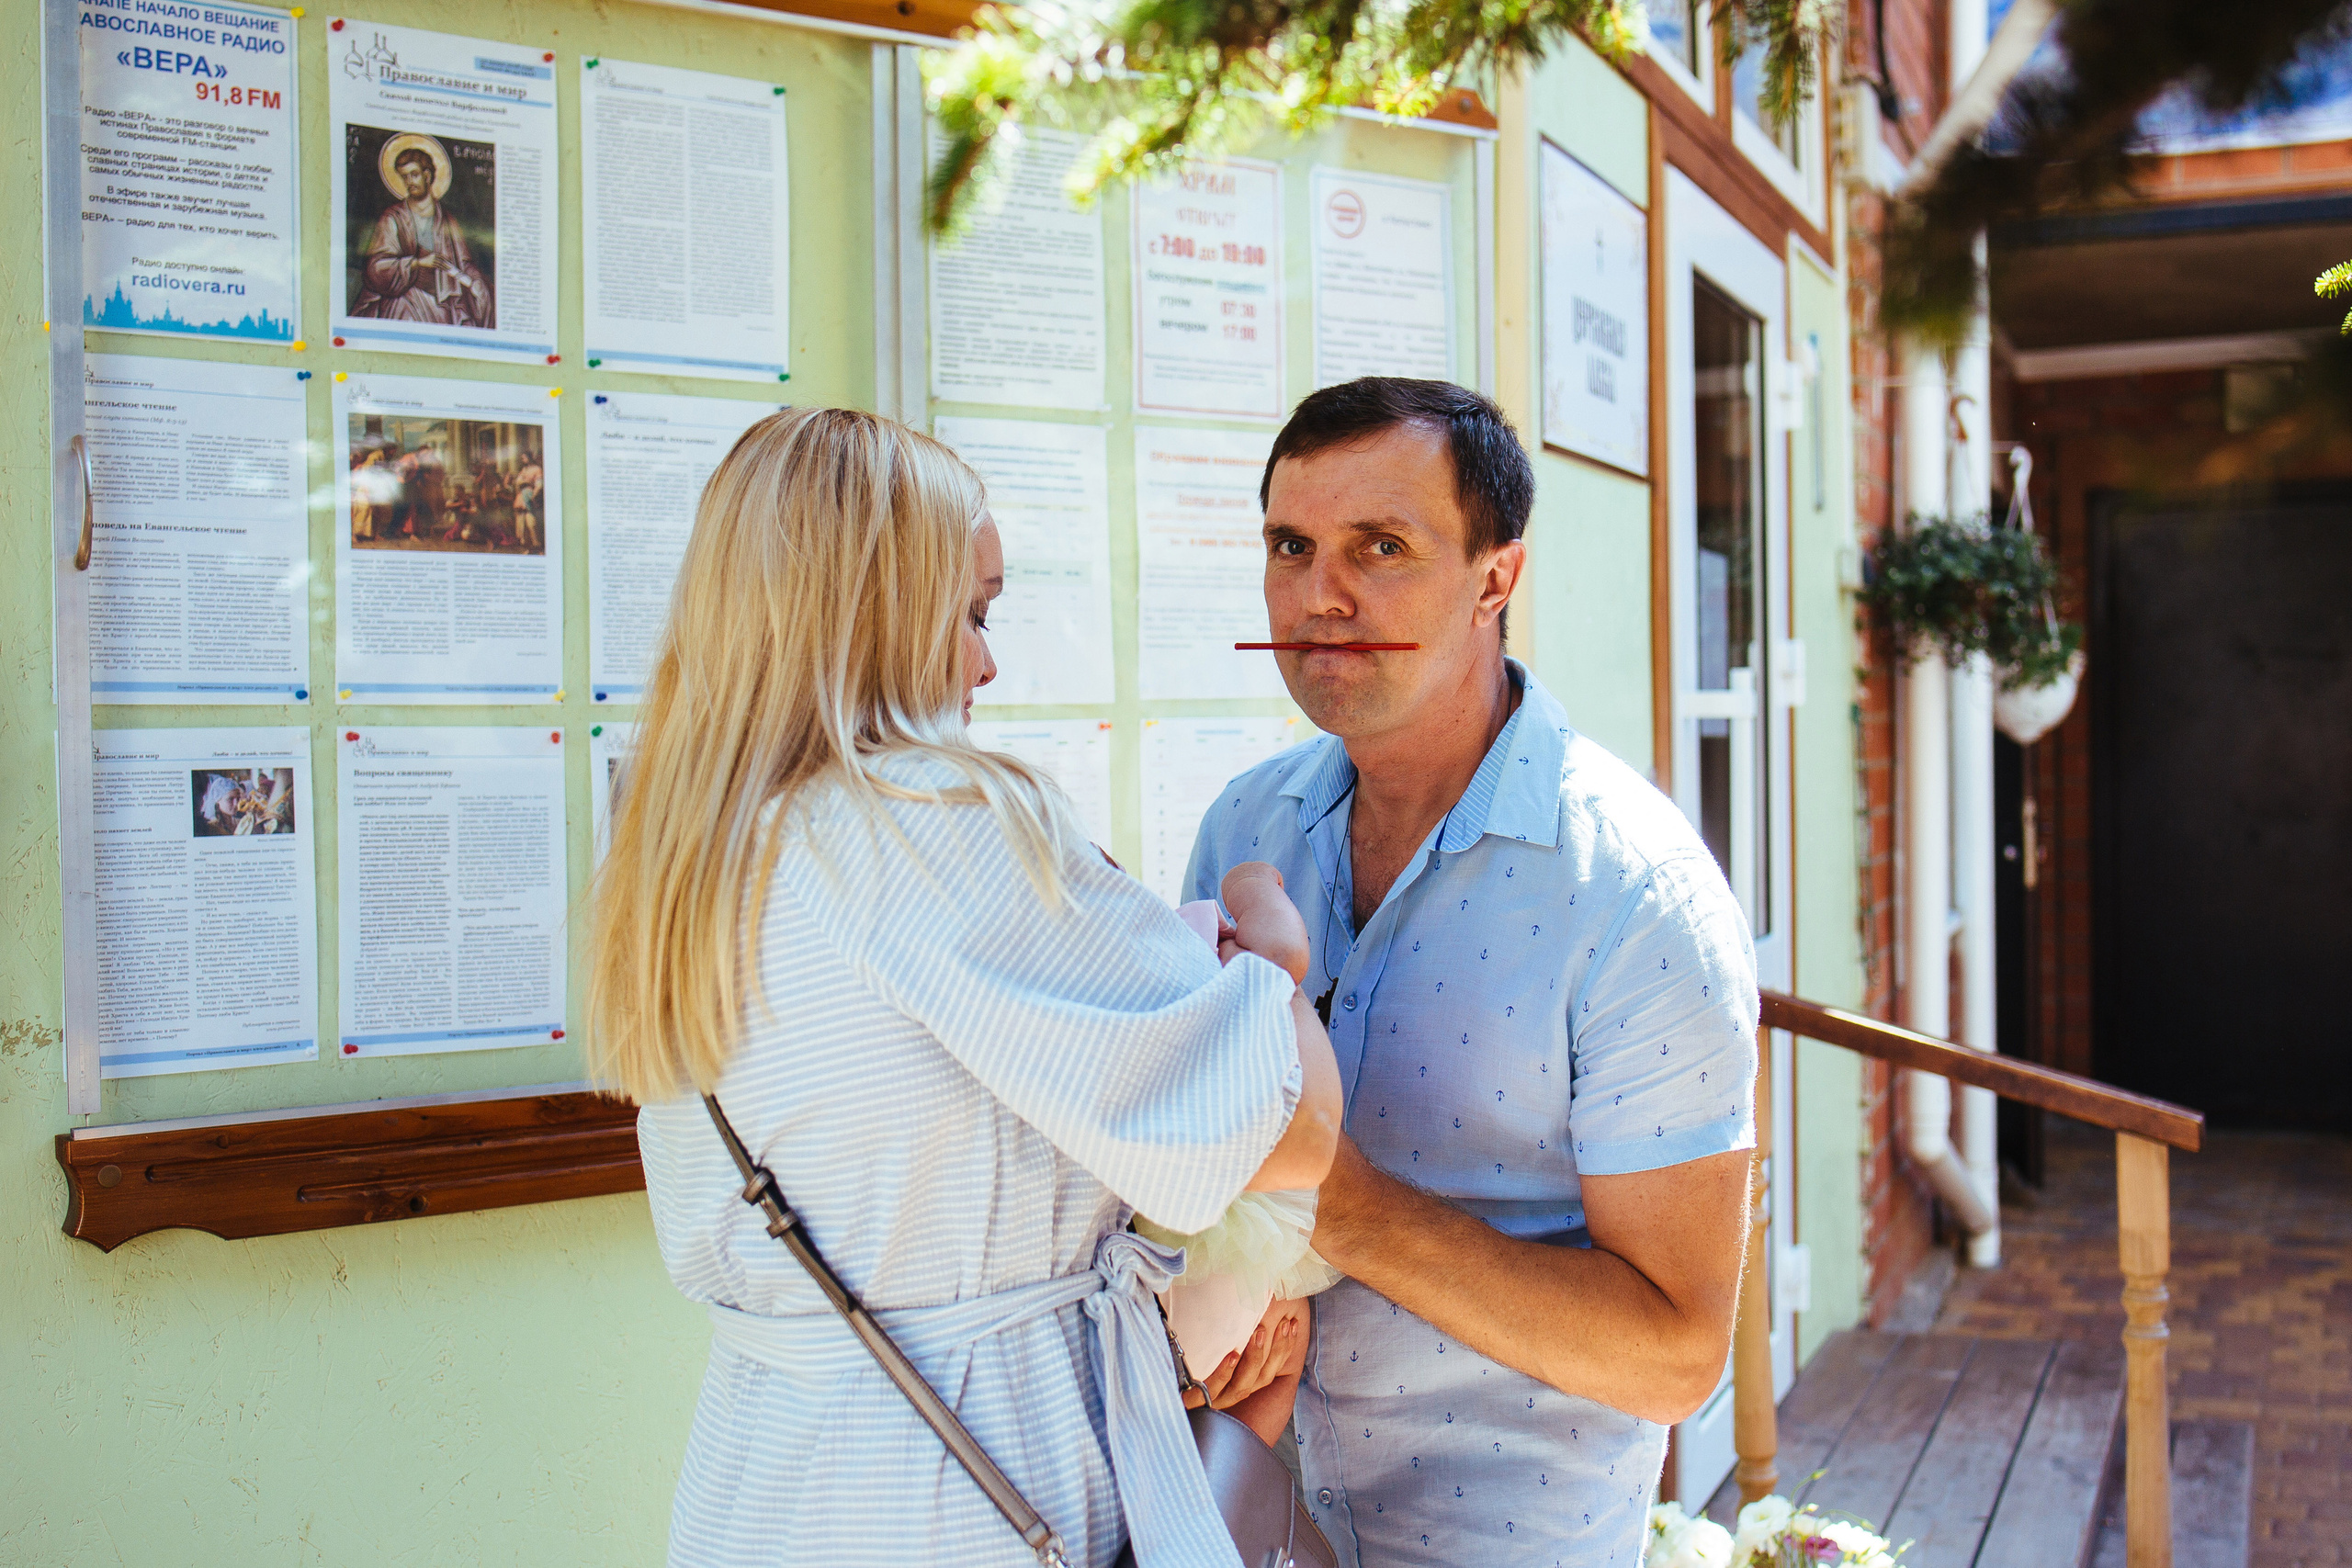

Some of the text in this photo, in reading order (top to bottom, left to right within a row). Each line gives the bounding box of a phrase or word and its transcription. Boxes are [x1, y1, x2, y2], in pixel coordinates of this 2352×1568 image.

[137, 1, 199, 20] НАЧАЛО
[204, 11, 280, 33] ВЕЩАНИЕ
[81, 12, 286, 54] АВОСЛАВНОЕ РАДИО
[118, 47, 228, 78] «ВЕРА»
[379, 64, 481, 91] Православие
[483, 83, 493, 93] и
[497, 85, 527, 100] мир
[196, 82, 281, 109] 91,8 FM
[85, 106, 117, 118] Радио
[165, 118, 181, 127] это
[183, 119, 226, 133] разговор
[236, 127, 269, 137] вечных
[100, 119, 138, 130] истинах
[214, 131, 255, 145] формате
[117, 130, 180, 144] современной
[80, 144, 111, 156] Среди
[114, 149, 130, 158] его
[132, 151, 177, 164] программ
[187, 157, 232, 170] рассказы
[87, 155, 128, 166] славных
[131, 160, 180, 173] страницах
[233, 173, 260, 183] детях
[89, 165, 119, 175] самых
[122, 168, 164, 181] обычных
[166, 174, 219, 186] жизненных
[88, 195, 161, 209] отечественная
[172, 203, 229, 217] зарубежная
[107, 186, 114, 194] В
[117, 187, 147, 198] эфире
[150, 191, 180, 201] также
[216, 199, 251, 209] лучшая
[126, 218, 156, 228] радио
[218, 227, 243, 236] хочет
[131, 256, 162, 268] Радио
[164, 262, 208, 274] доступно
[131, 274, 246, 296] radiovera.ru
[144, 523, 211, 534] Евангельское
